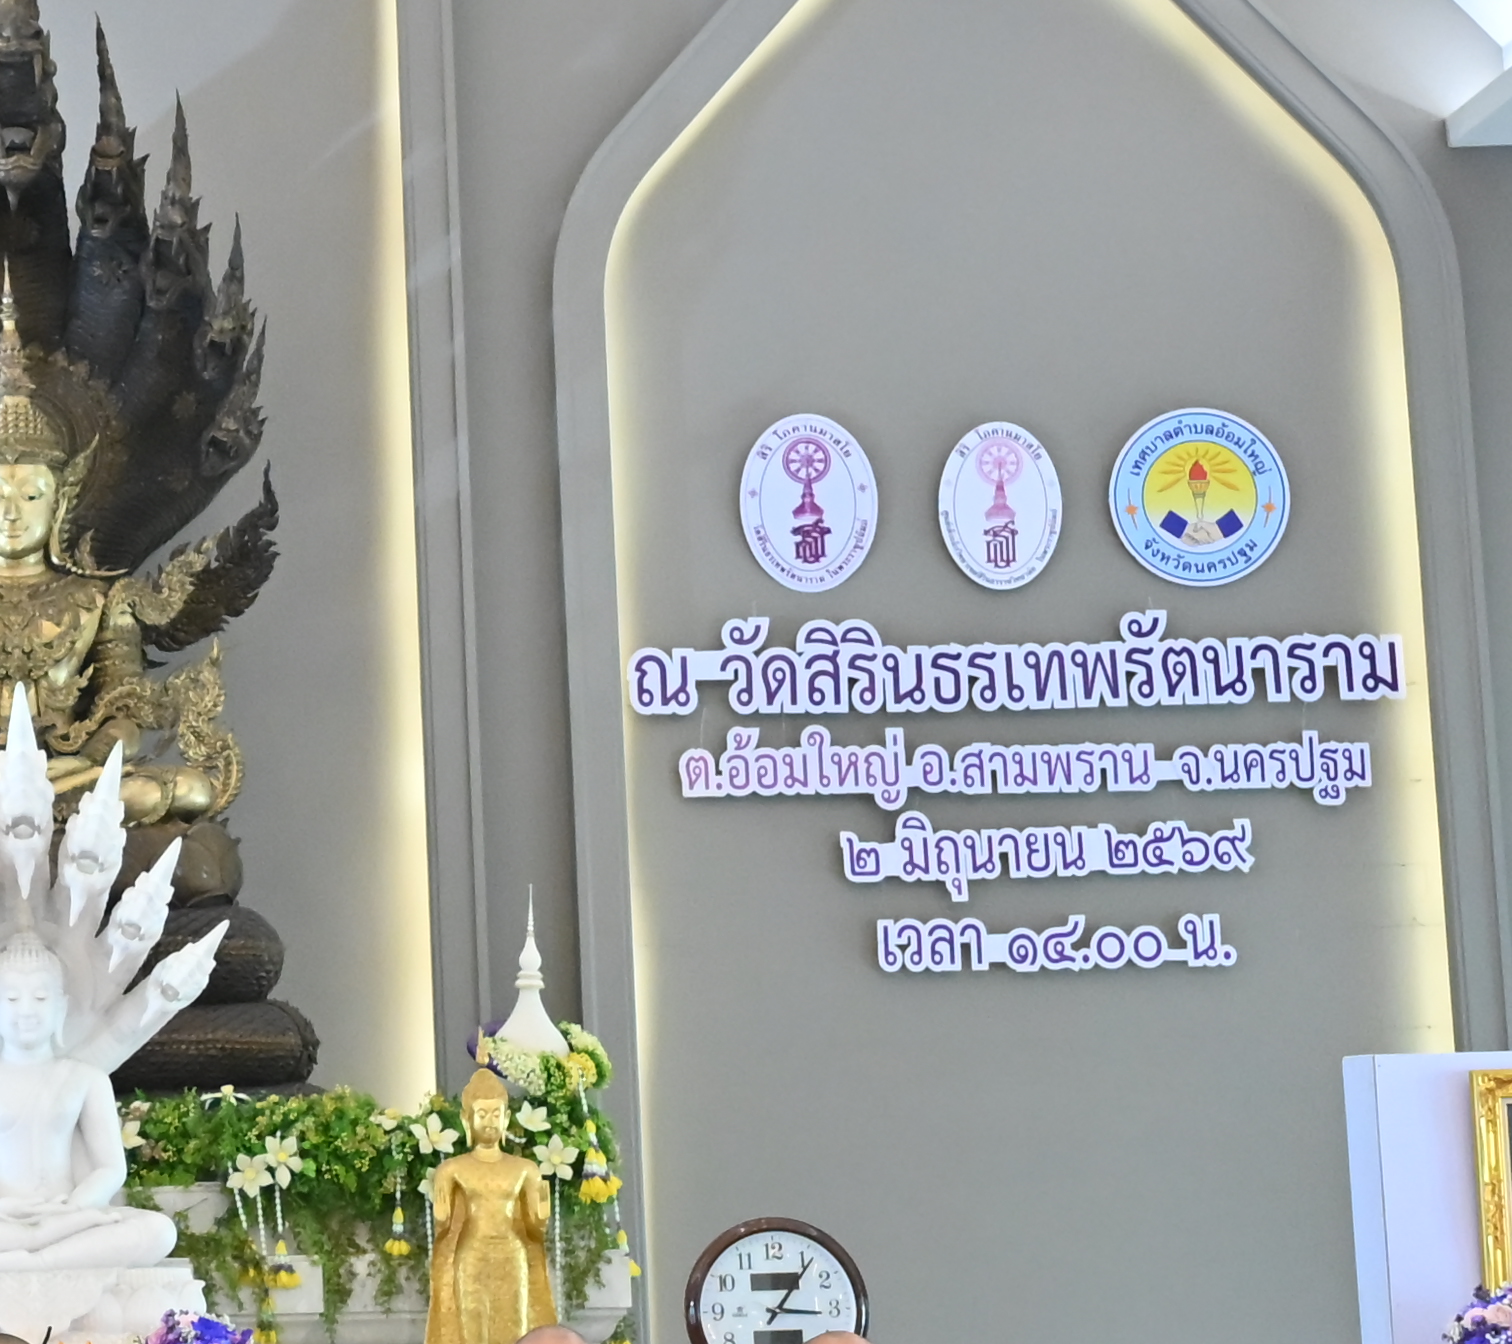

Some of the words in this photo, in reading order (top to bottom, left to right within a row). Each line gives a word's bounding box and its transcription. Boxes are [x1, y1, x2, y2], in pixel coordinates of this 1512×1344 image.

[1129, 419, 1273, 477] เทศบาลตำบลอ้อมใหญ่
[1144, 536, 1258, 574] จังหวัดนครปฐม
[633, 653, 691, 708] ณ
[719, 615, 1401, 707] วัดสิรินธรเทพรัตนาราม
[684, 731, 901, 805] ต.อ้อมใหญ่
[920, 748, 1151, 788] อ.สามพราน
[1177, 735, 1368, 800] จ.นครปฐม
[845, 836, 881, 877] ๒
[900, 816, 1086, 896] มิถุนายน
[1103, 823, 1248, 870] ๒๕๖๙
[882, 922, 983, 967] เวลา
[1007, 919, 1163, 966] ๑๔.๐๐
[1183, 918, 1232, 961] น.
[737, 1252, 753, 1271] 11
[763, 1241, 784, 1261] 12
[718, 1274, 736, 1292] 10
[818, 1270, 832, 1290] 2
[711, 1302, 725, 1321] 9
[828, 1299, 841, 1318] 3
